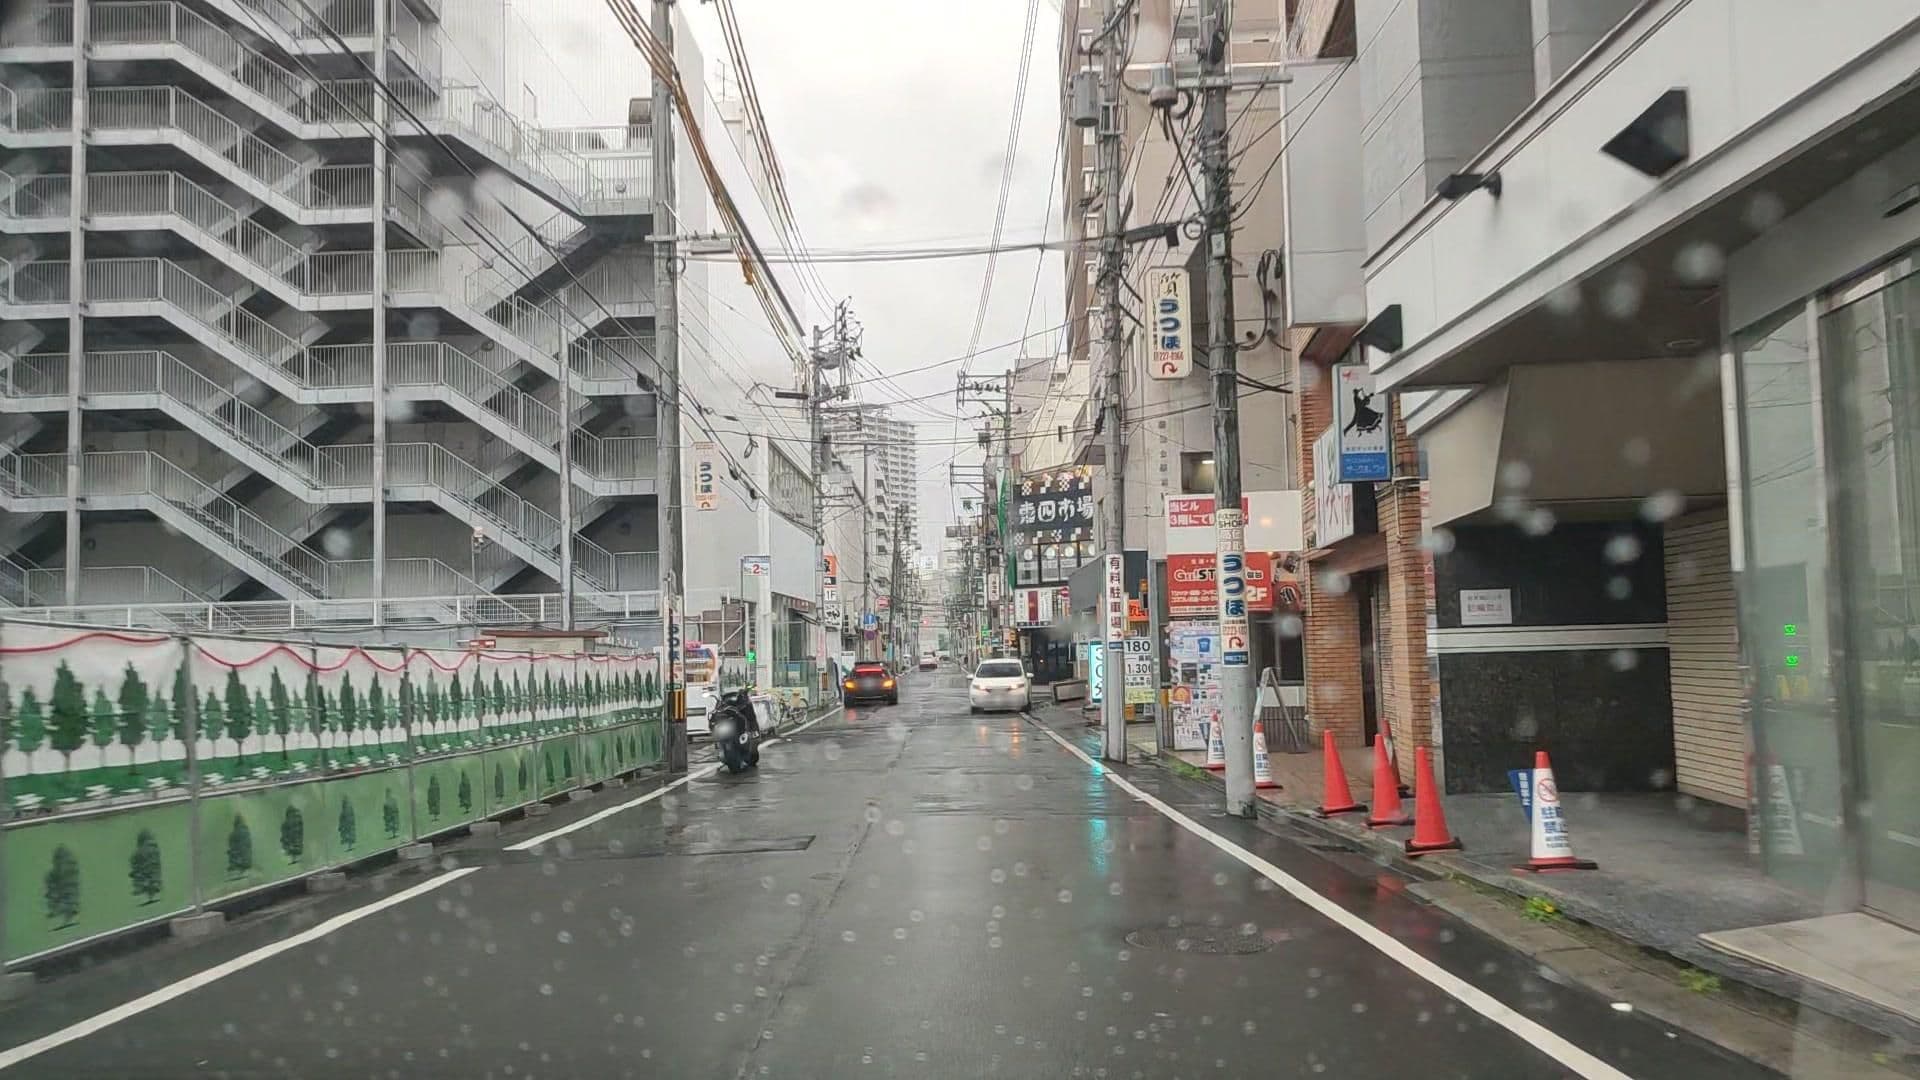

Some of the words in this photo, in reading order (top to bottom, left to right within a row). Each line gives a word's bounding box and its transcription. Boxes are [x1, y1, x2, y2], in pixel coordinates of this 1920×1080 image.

[1160, 299, 1181, 351] うつほ
[700, 462, 713, 493] うつほ
[1169, 501, 1199, 512] 当ビル
[1218, 520, 1243, 528] SHOP
[1110, 557, 1122, 628] 有料駐車場
[1223, 554, 1245, 616] うつほ
[1248, 586, 1268, 600] 2F
[1125, 641, 1151, 652] 180
